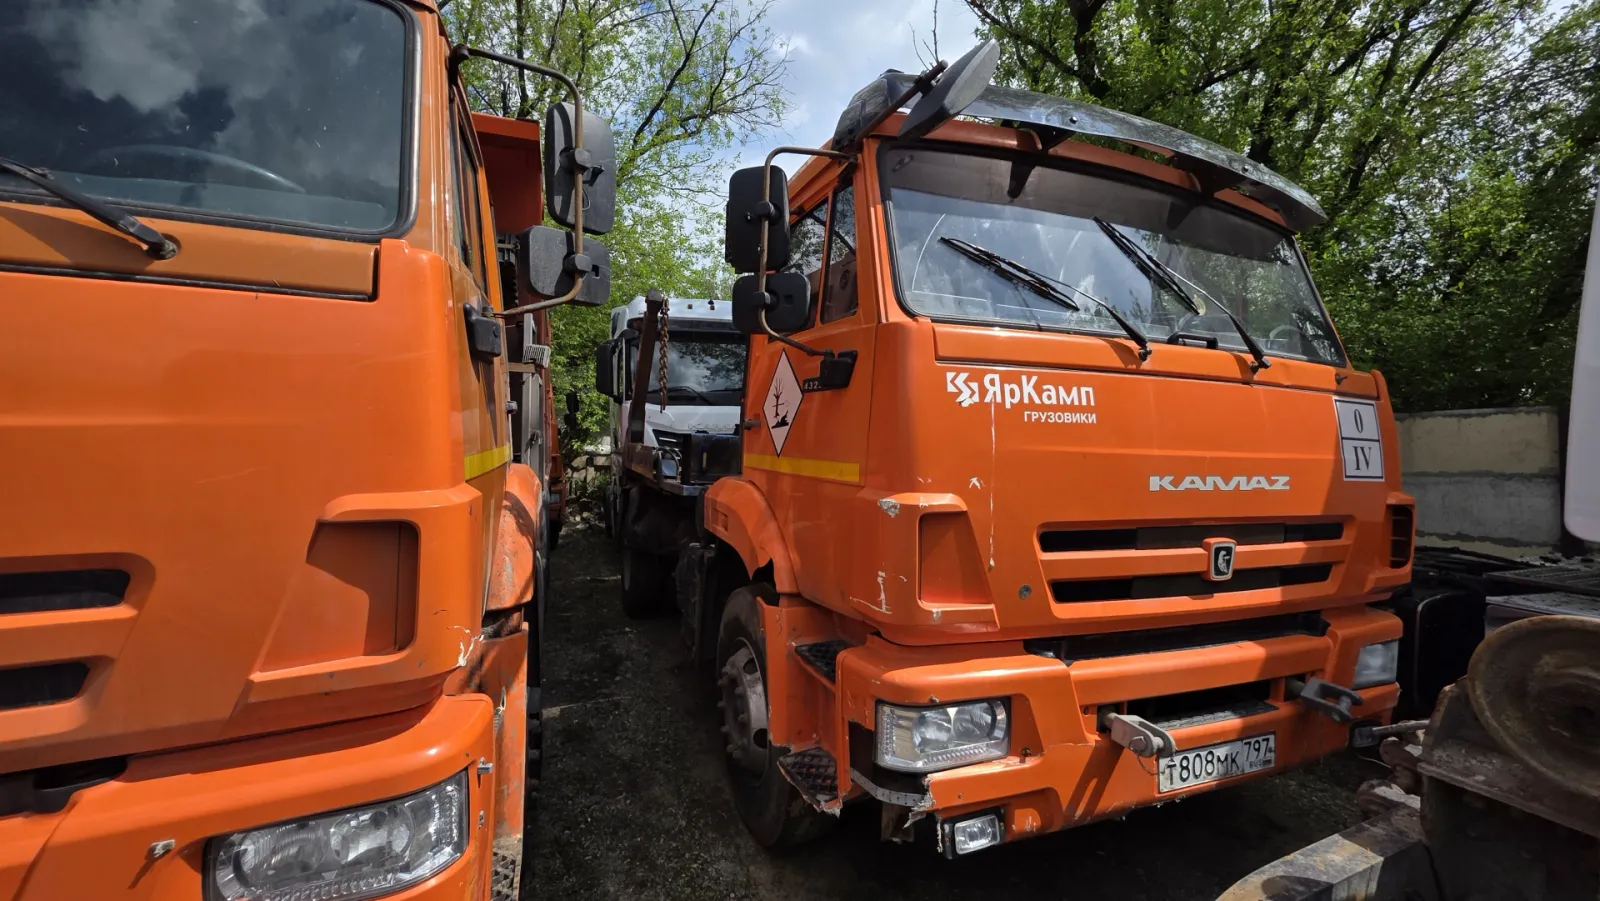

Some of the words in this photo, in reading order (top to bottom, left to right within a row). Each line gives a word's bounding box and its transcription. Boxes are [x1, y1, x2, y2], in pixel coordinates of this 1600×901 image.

[804, 381, 822, 390] 432
[983, 373, 1095, 409] ЯрКамп
[1024, 411, 1097, 424] ГРУЗОВИКИ
[1352, 446, 1372, 471] IV
[1149, 475, 1290, 492] KAMAZ
[1243, 737, 1270, 762] 797
